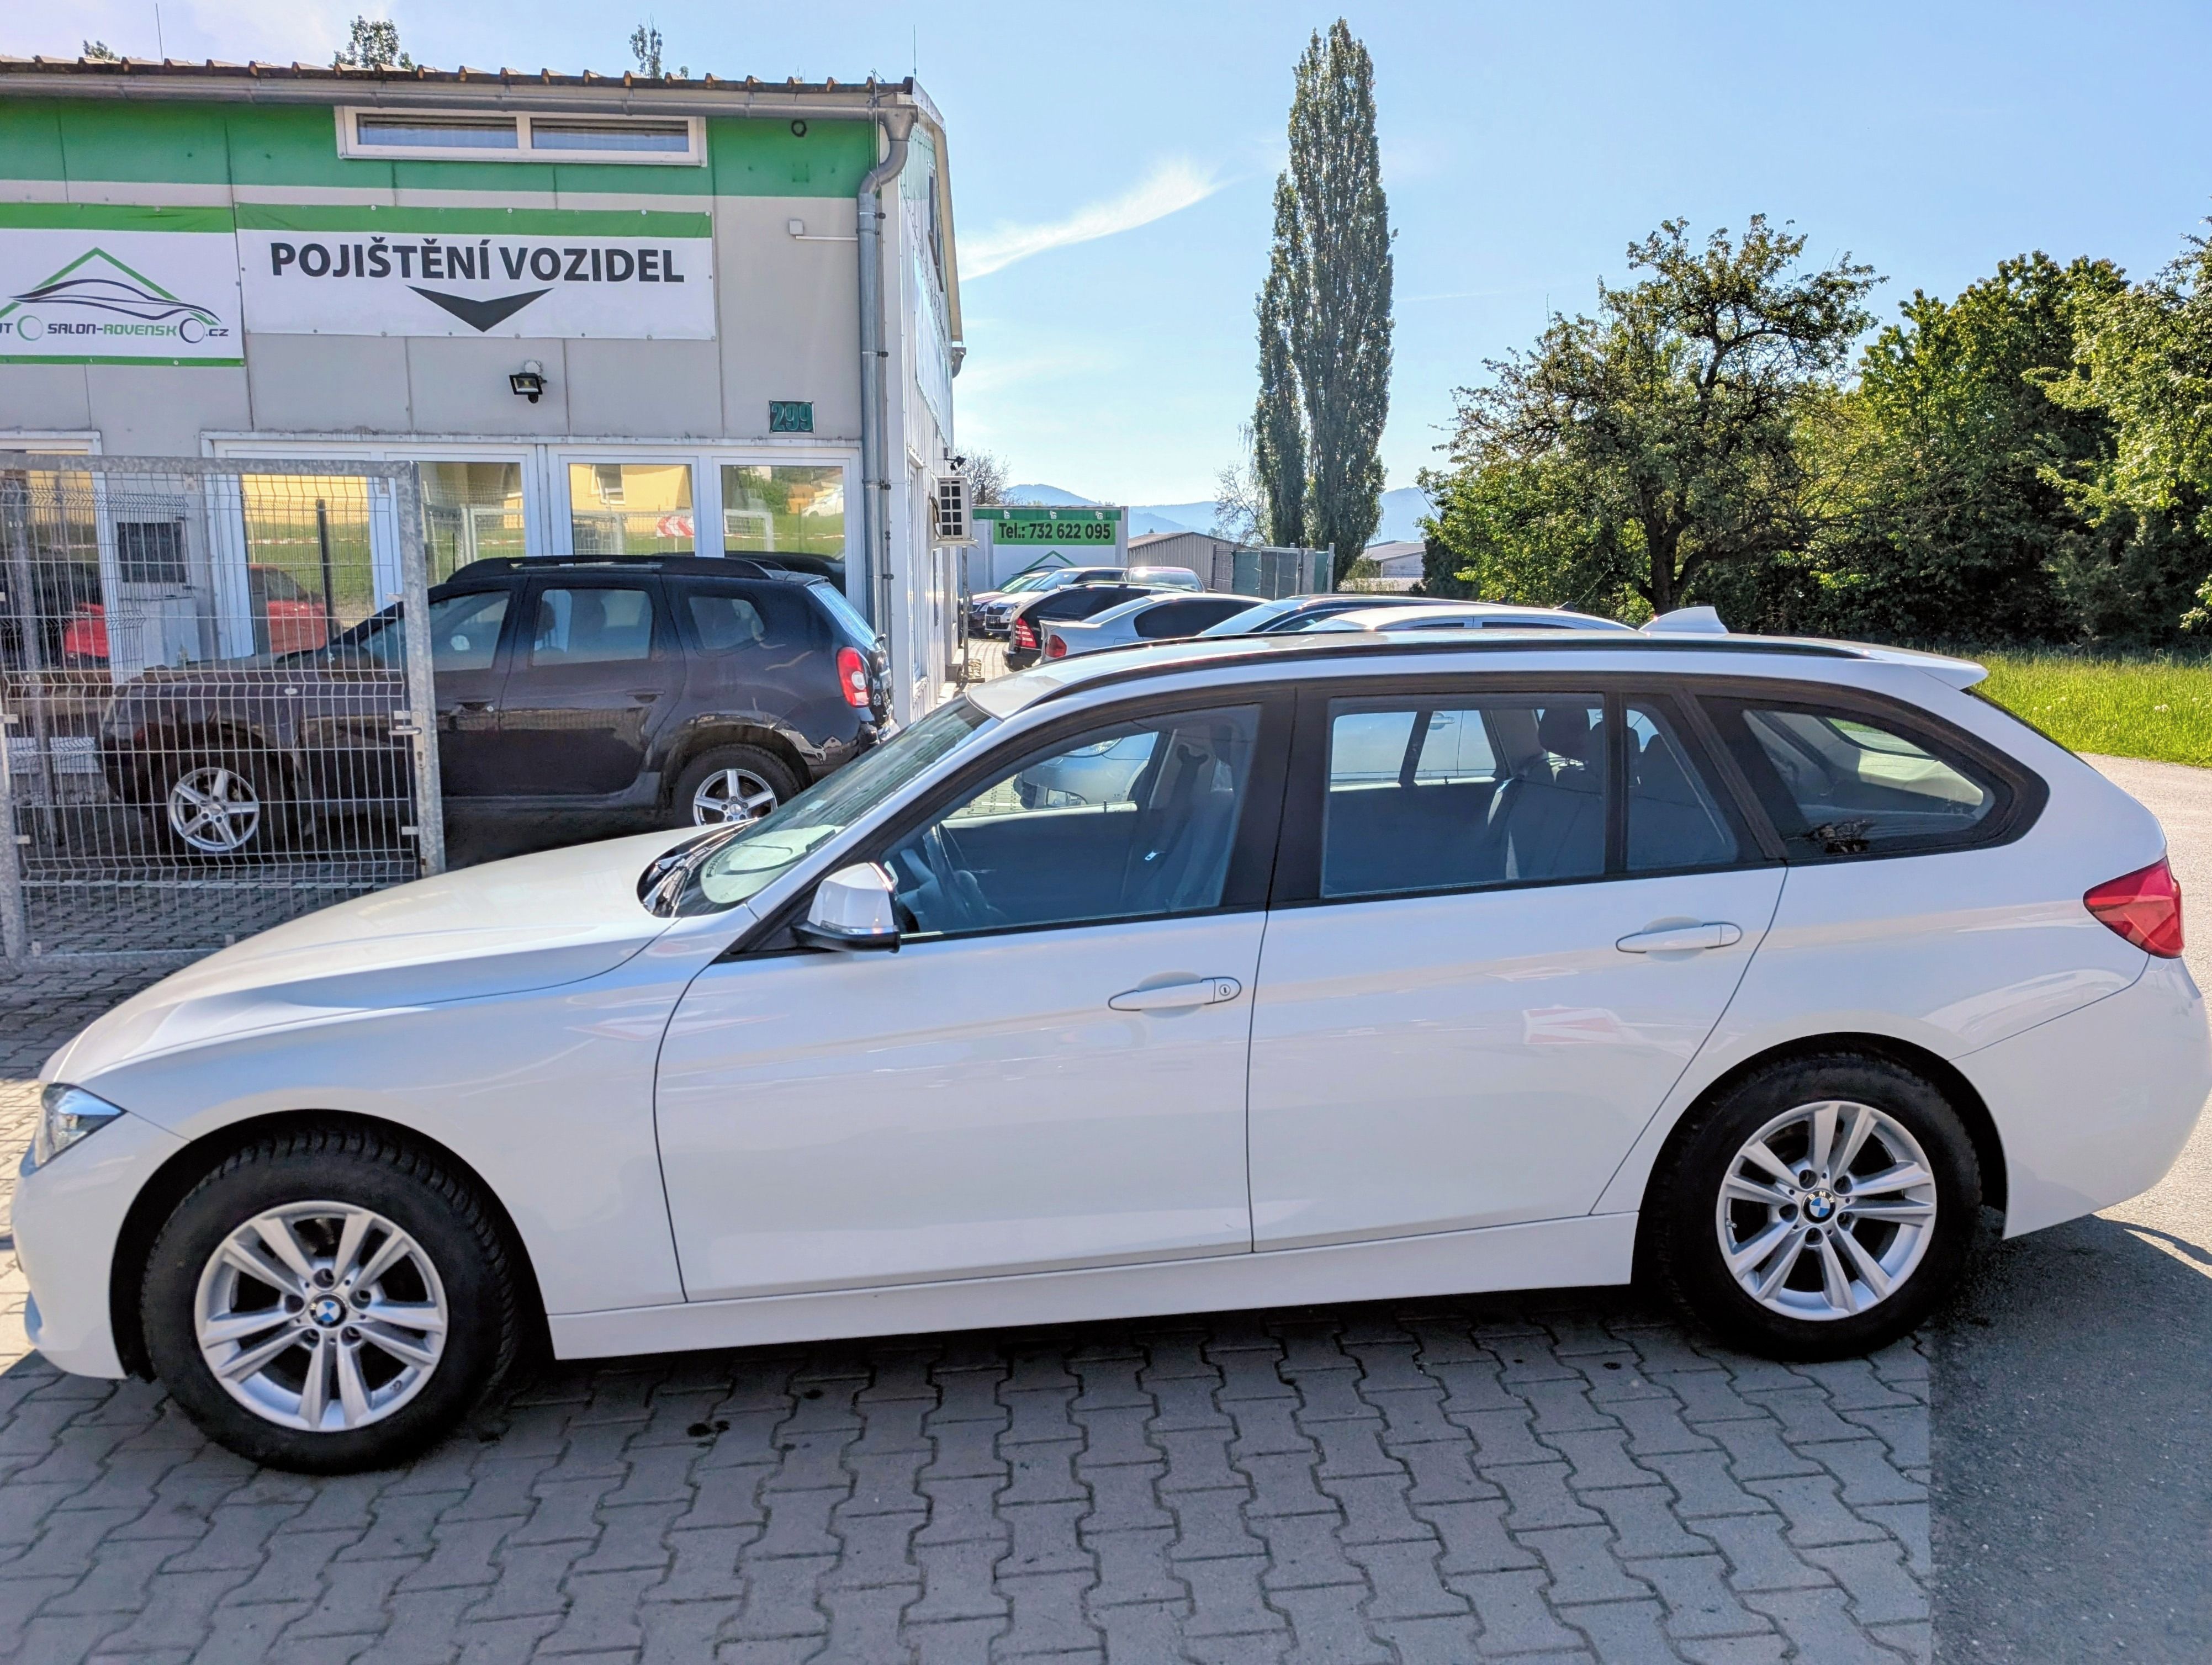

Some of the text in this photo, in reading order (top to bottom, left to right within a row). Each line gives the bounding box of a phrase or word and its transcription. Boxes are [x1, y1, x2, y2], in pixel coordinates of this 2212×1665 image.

[271, 236, 685, 283] POJIŠTĚNÍ VOZIDEL
[771, 403, 813, 431] 299
[999, 523, 1110, 539] Tel.: 732 622 095
[1808, 1191, 1835, 1203] BMW
